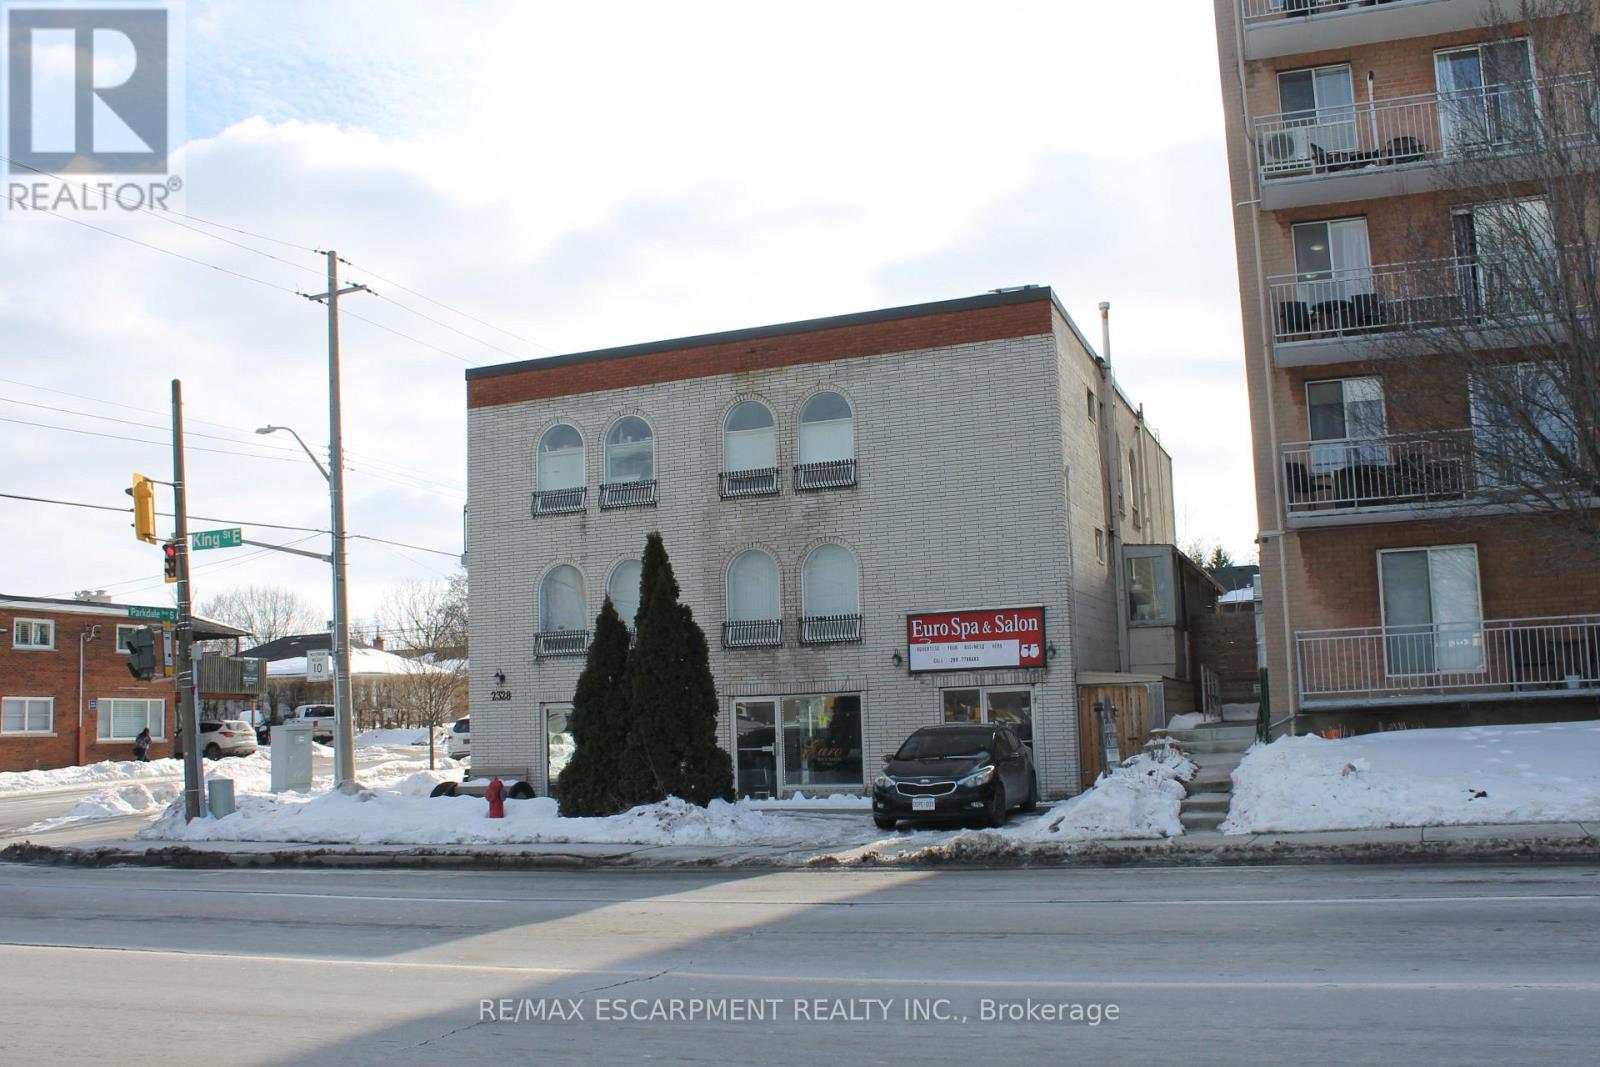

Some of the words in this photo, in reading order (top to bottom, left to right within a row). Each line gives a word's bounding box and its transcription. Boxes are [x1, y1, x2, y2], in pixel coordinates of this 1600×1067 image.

[192, 533, 220, 549] King
[222, 530, 231, 539] St
[233, 529, 241, 544] E
[130, 607, 160, 618] Parkdale
[169, 610, 175, 620] S
[911, 620, 949, 637] Euro
[951, 616, 979, 639] Spa
[982, 621, 991, 633] &
[995, 614, 1038, 633] Salon
[313, 663, 322, 673] 10
[491, 691, 511, 701] 2328
